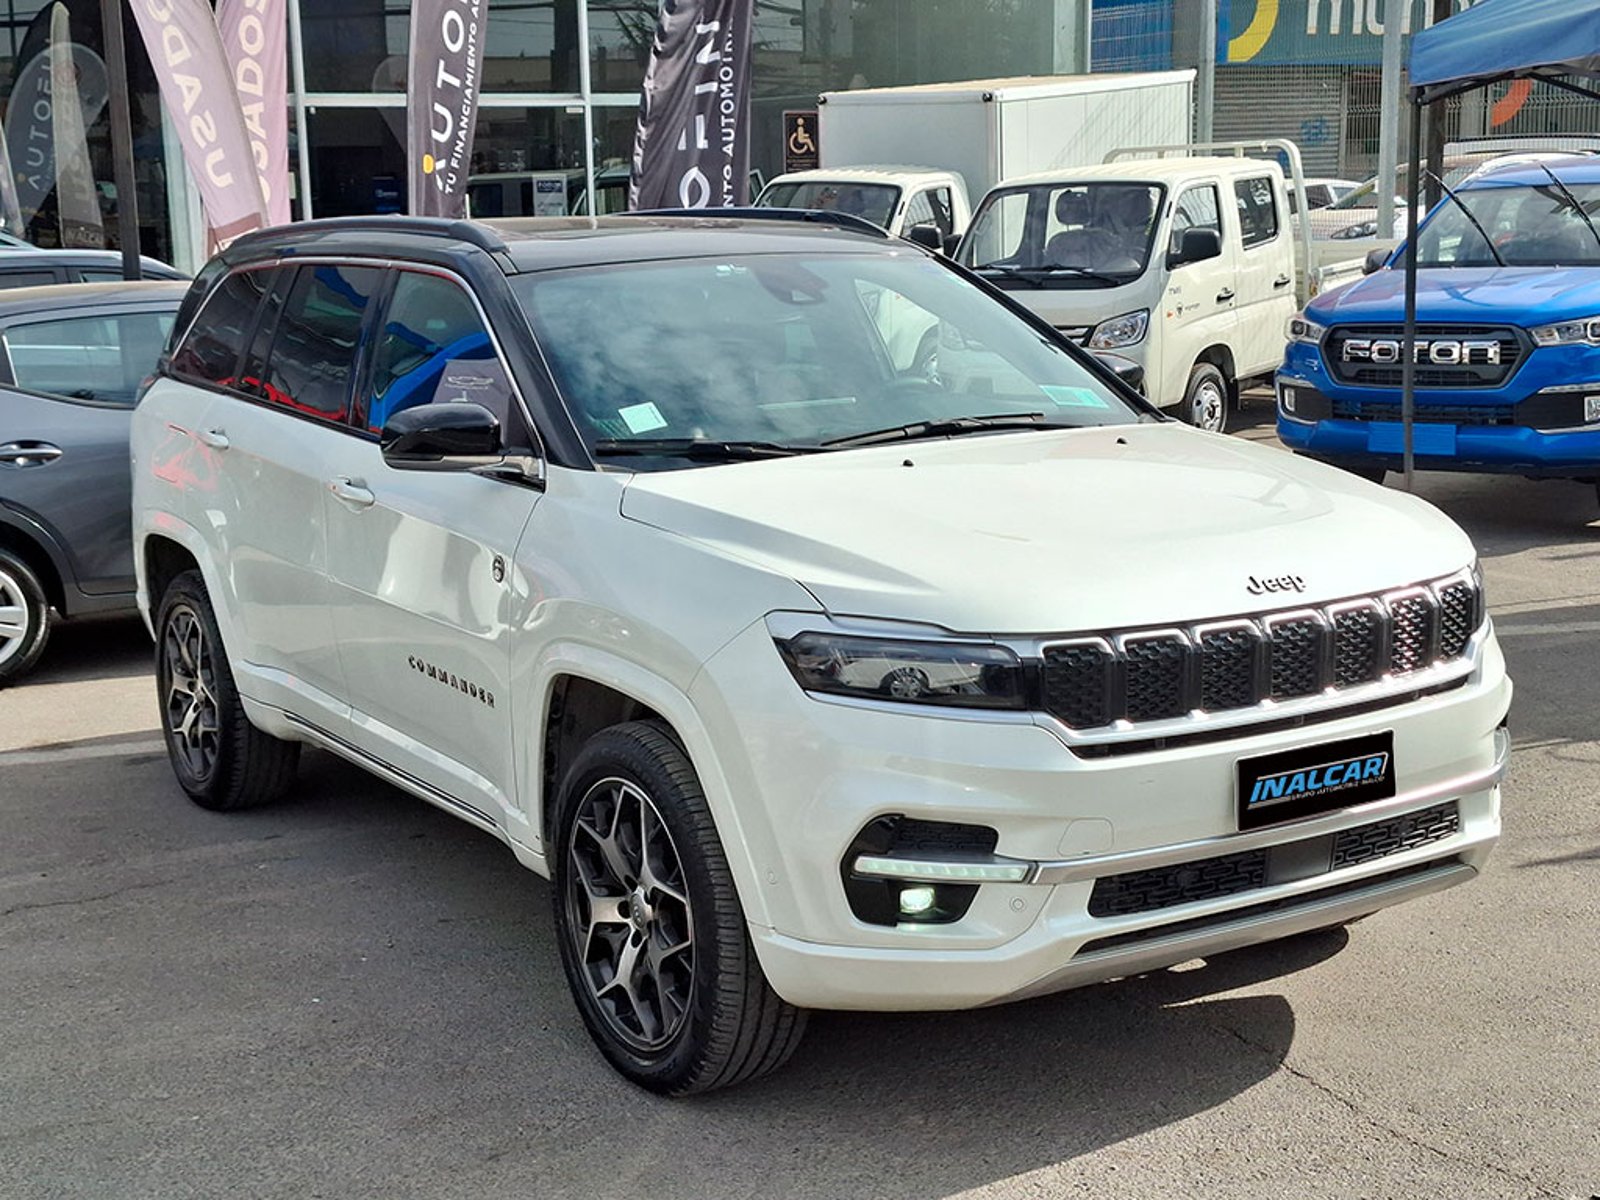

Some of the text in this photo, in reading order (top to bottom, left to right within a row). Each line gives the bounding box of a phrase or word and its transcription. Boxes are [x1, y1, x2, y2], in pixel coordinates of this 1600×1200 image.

[430, 0, 468, 192] AUTO
[450, 23, 478, 169] FINANCIAMIENTO
[444, 171, 457, 195] TU
[1343, 339, 1500, 365] FOTON
[1246, 574, 1306, 596] Jeep
[408, 655, 494, 708] COMMANDER
[1250, 757, 1383, 802] INALCAR
